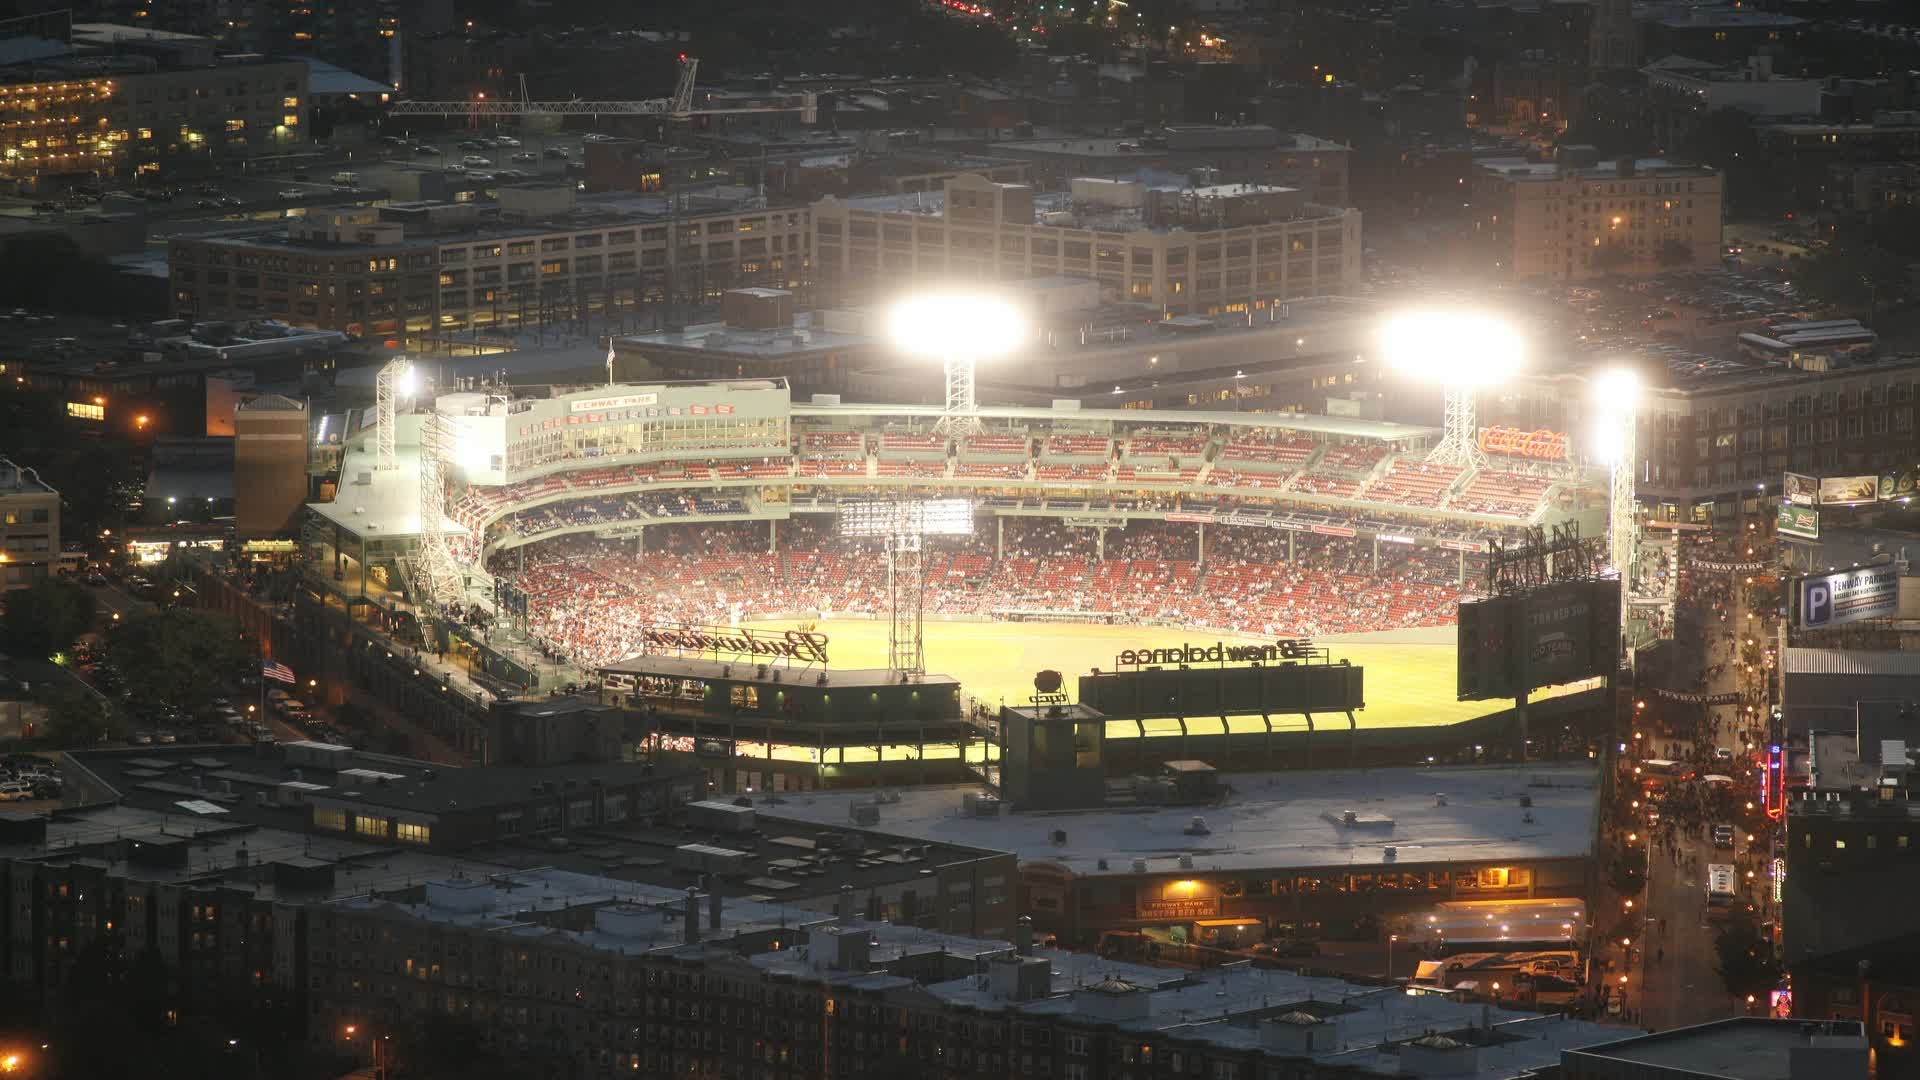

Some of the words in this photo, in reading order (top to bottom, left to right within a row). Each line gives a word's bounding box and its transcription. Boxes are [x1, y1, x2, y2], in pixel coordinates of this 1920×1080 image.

[576, 399, 618, 409] FENWAY
[623, 396, 652, 405] PARK
[1691, 560, 1731, 570] FENWAY
[1735, 562, 1763, 571] PARK
[1809, 587, 1828, 622] P
